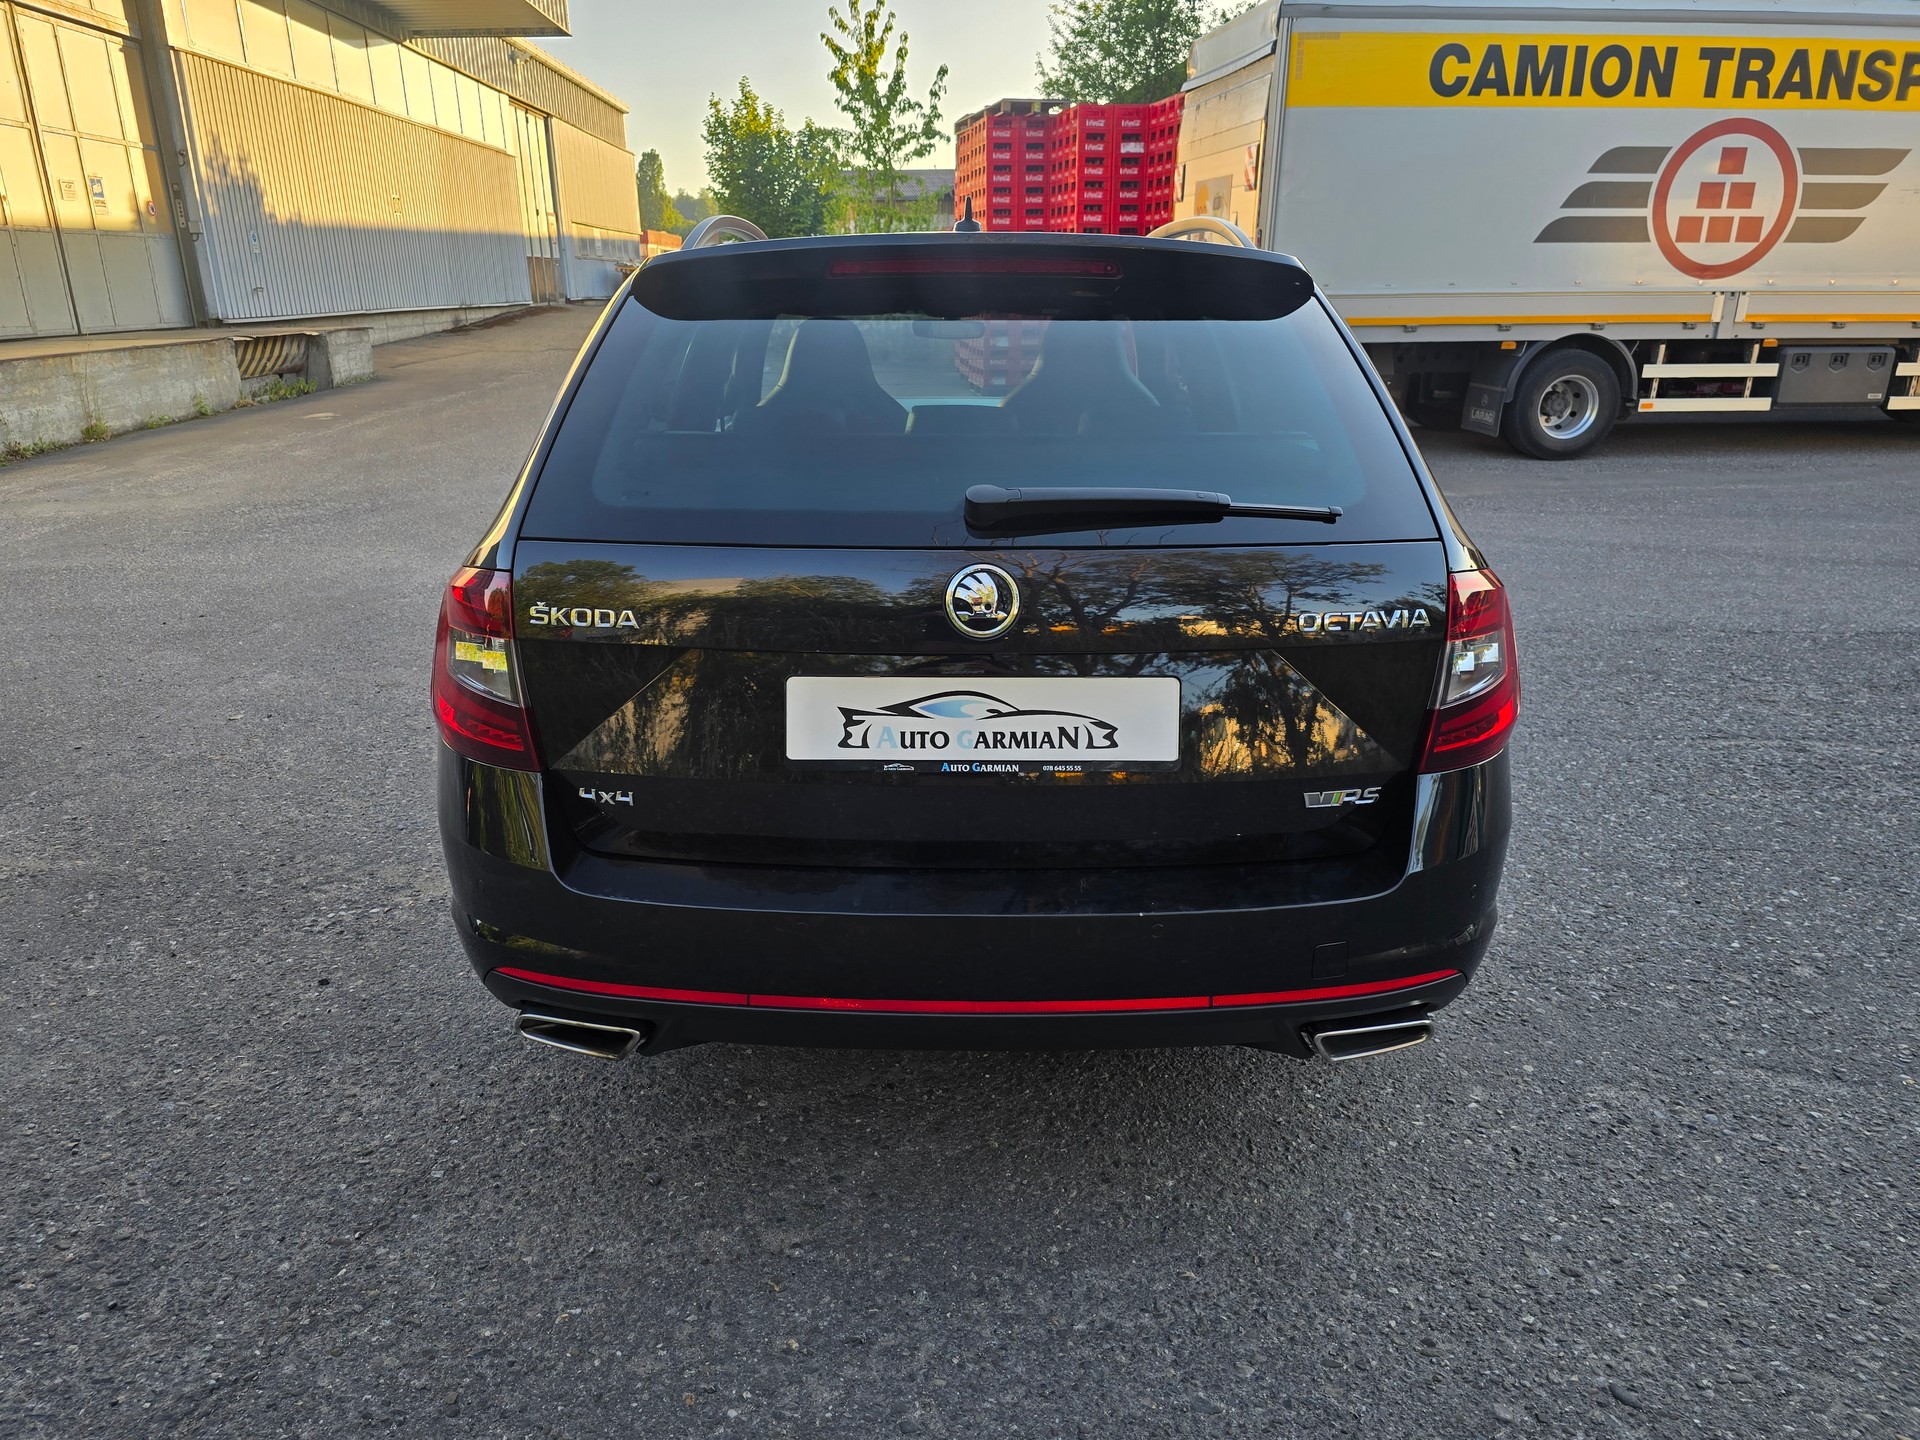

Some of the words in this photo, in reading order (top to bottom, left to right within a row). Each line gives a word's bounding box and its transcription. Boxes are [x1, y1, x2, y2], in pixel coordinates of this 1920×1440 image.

[1428, 42, 1679, 98] CAMION
[1698, 46, 1920, 102] TRANSP
[529, 601, 640, 630] ŠKODA
[1298, 608, 1432, 632] OCTAVIA
[876, 726, 950, 750] AUTO
[956, 726, 1080, 750] GARMIAN
[941, 762, 970, 772] AUTO
[972, 762, 1019, 772] GARMIAN
